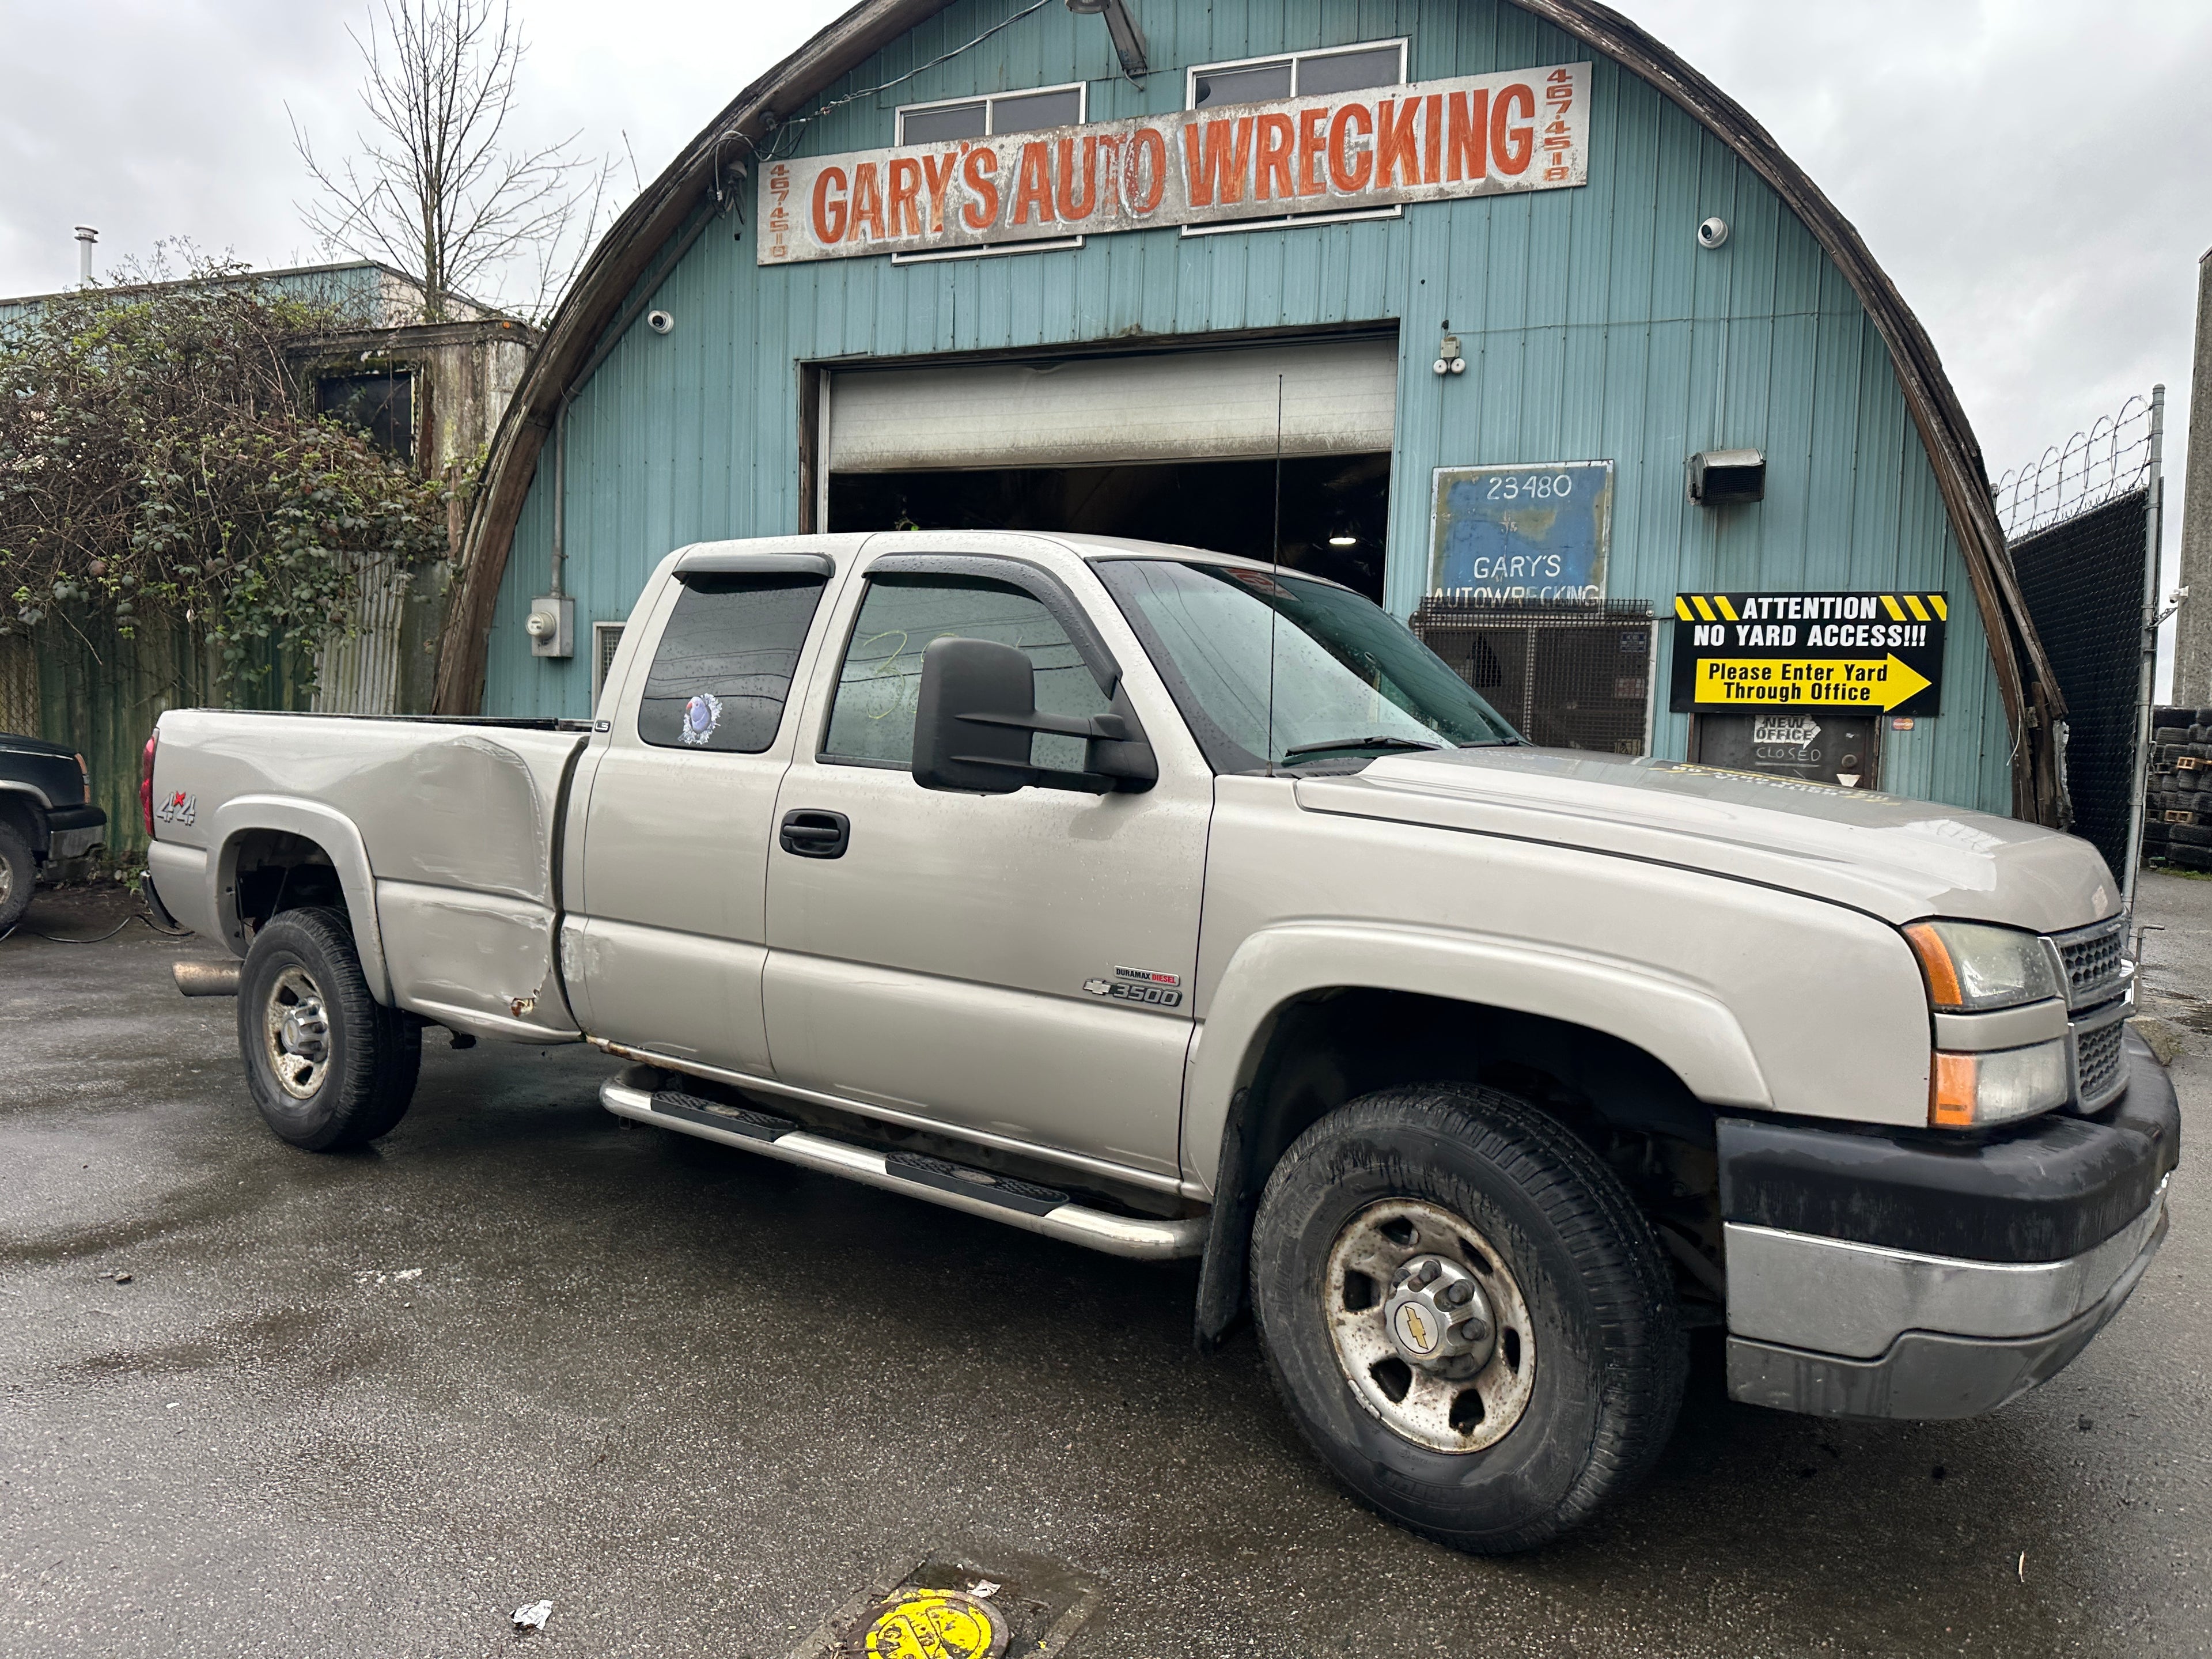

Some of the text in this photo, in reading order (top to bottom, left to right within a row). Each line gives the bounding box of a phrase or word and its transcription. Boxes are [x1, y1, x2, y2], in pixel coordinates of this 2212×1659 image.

[812, 83, 1535, 244] GARY'S AUTO WRECKING
[1486, 474, 1572, 500] 23480
[1474, 554, 1562, 578] GARY'S
[1742, 596, 1877, 620] ATTENTION
[1694, 624, 1927, 647] NO YARD ACCESS!!!
[1709, 662, 1888, 681] Please Enter Yard
[1724, 682, 1871, 702] Through Office
[595, 722, 609, 730] LS
[1764, 716, 1804, 729] NEW
[1756, 727, 1813, 741] OFFICE
[1756, 747, 1821, 761] CLOSED
[1116, 968, 1176, 984] DURAMAX DIESEL
[1113, 983, 1181, 1007] 3500
